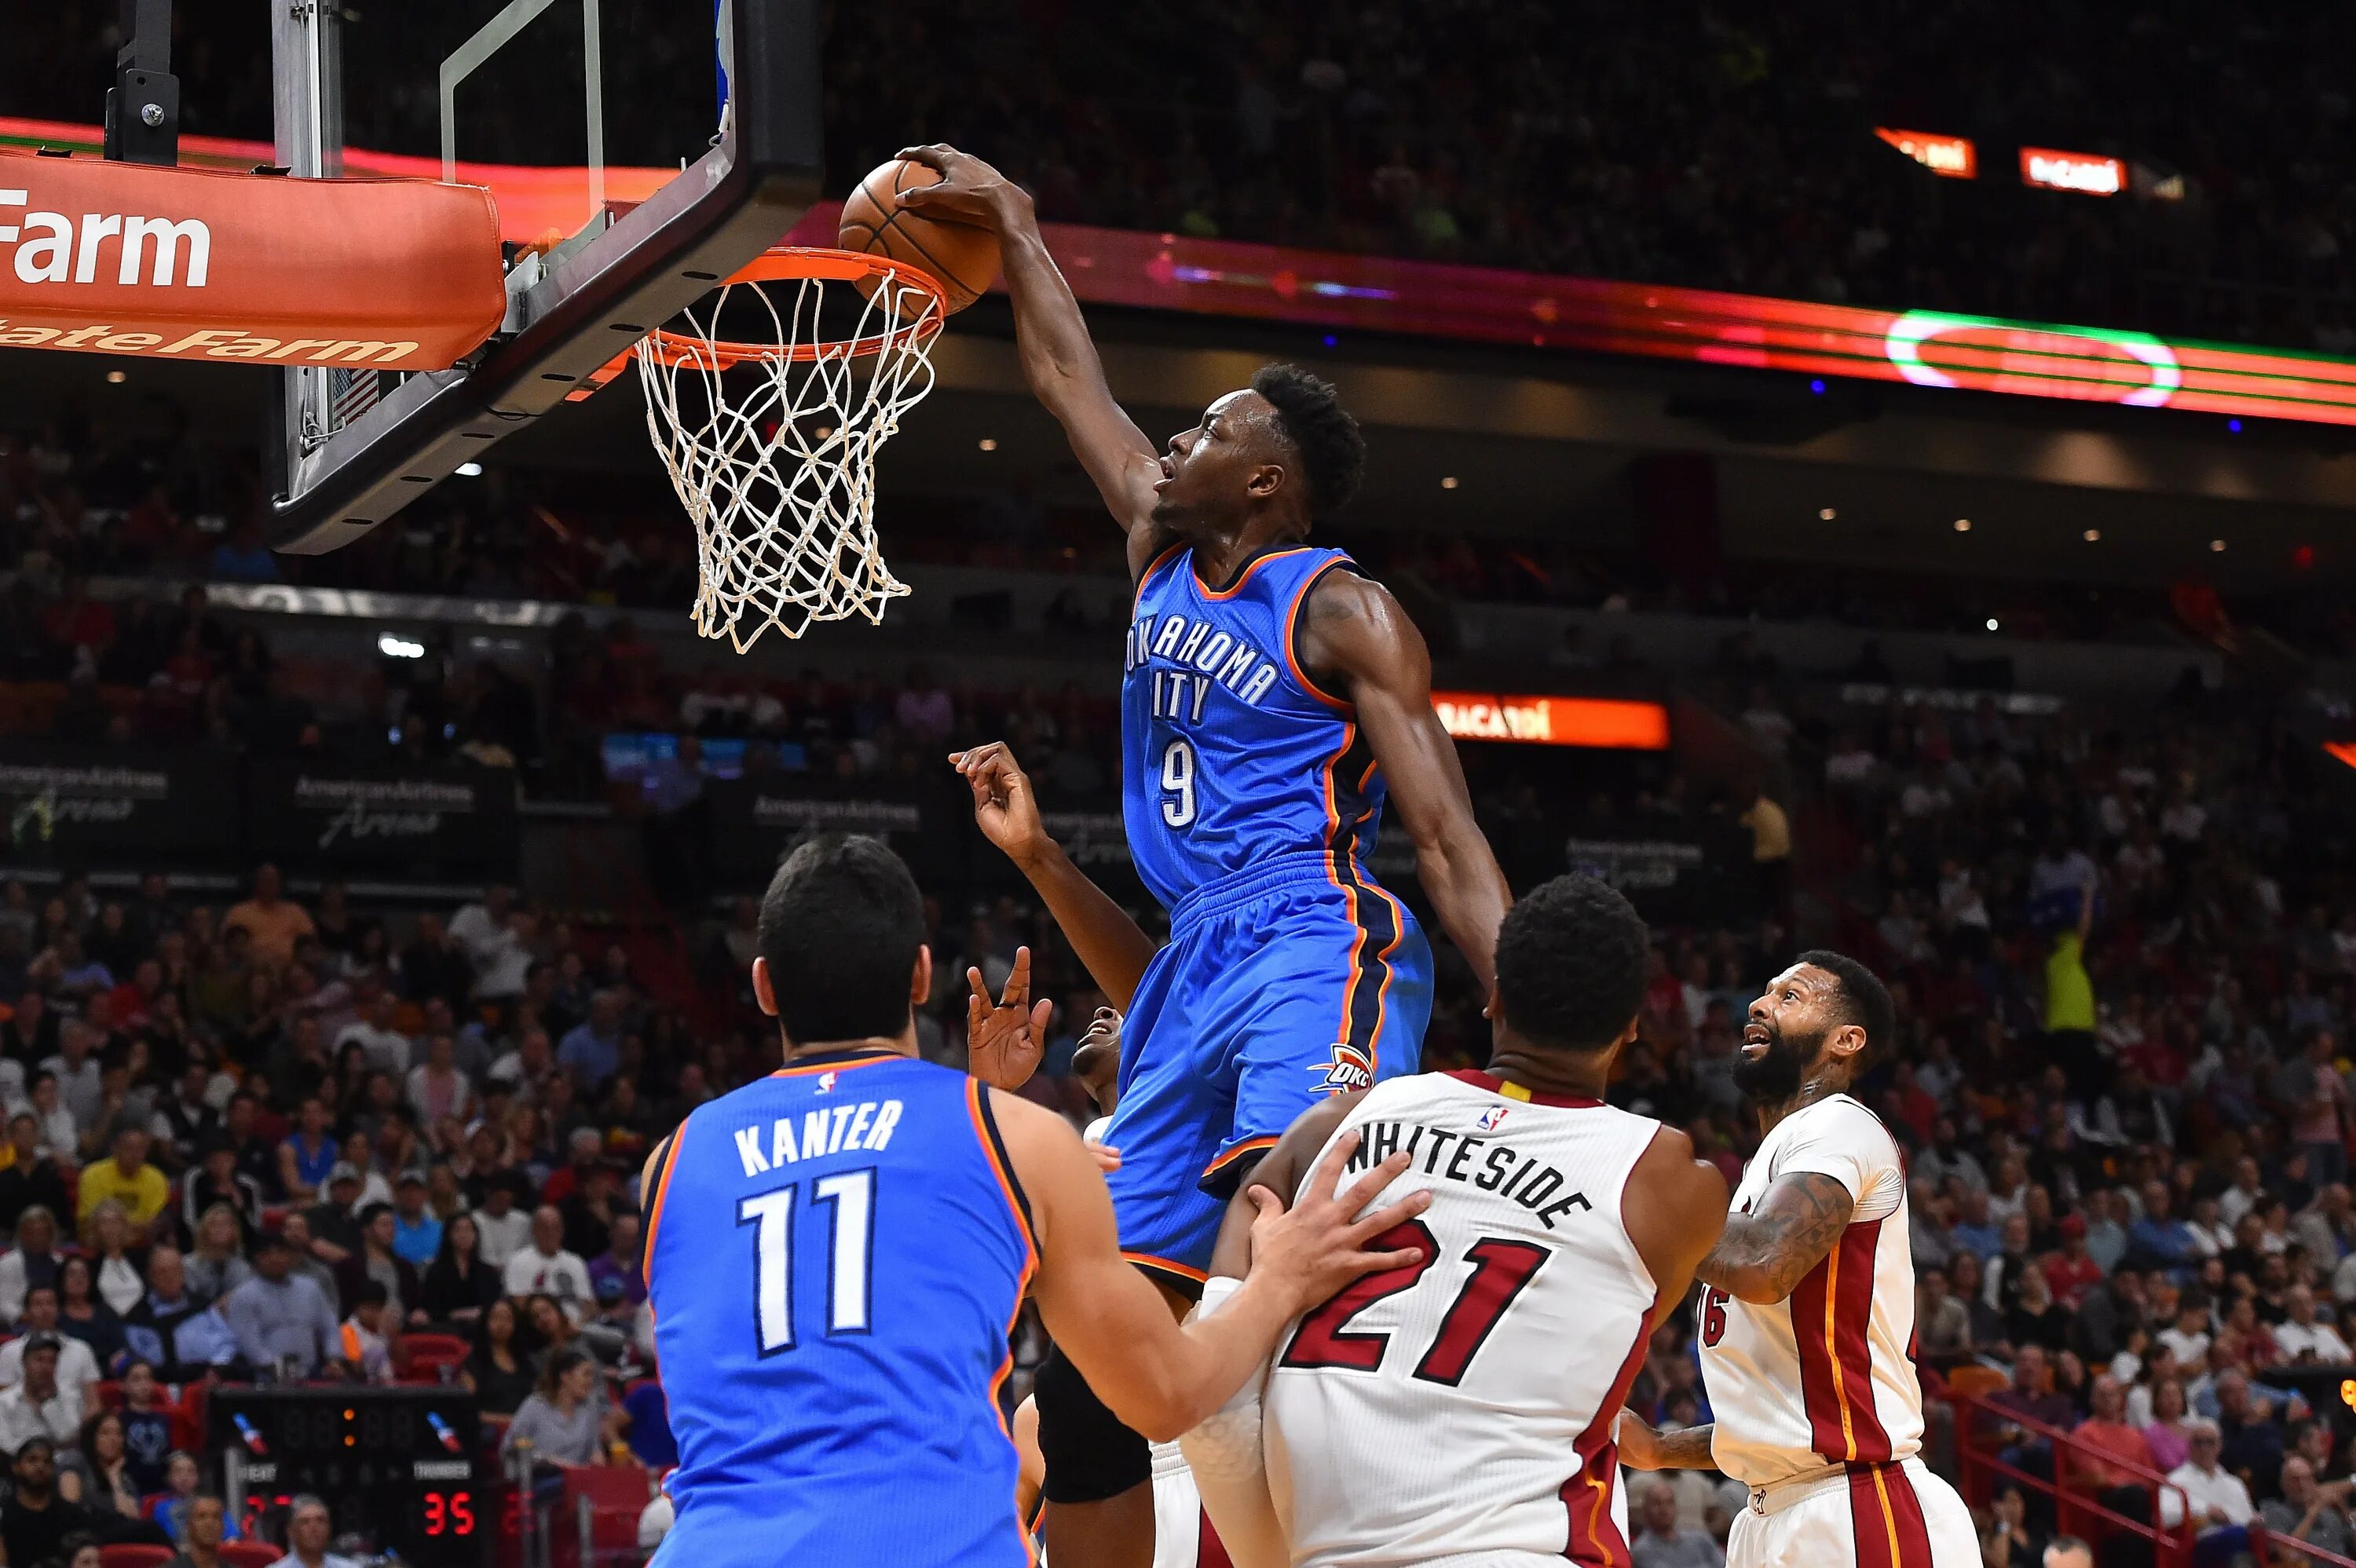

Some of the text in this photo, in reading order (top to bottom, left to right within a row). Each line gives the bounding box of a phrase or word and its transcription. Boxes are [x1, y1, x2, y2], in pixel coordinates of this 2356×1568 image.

[155, 330, 419, 363] Farm
[1154, 671, 1210, 721] ITY
[1162, 741, 1194, 828] 9
[1329, 1062, 1370, 1087] OKC
[734, 1100, 903, 1177] KANTER
[736, 1166, 877, 1359] 11
[1279, 1219, 1552, 1387] 21
[424, 1492, 474, 1537] 35
